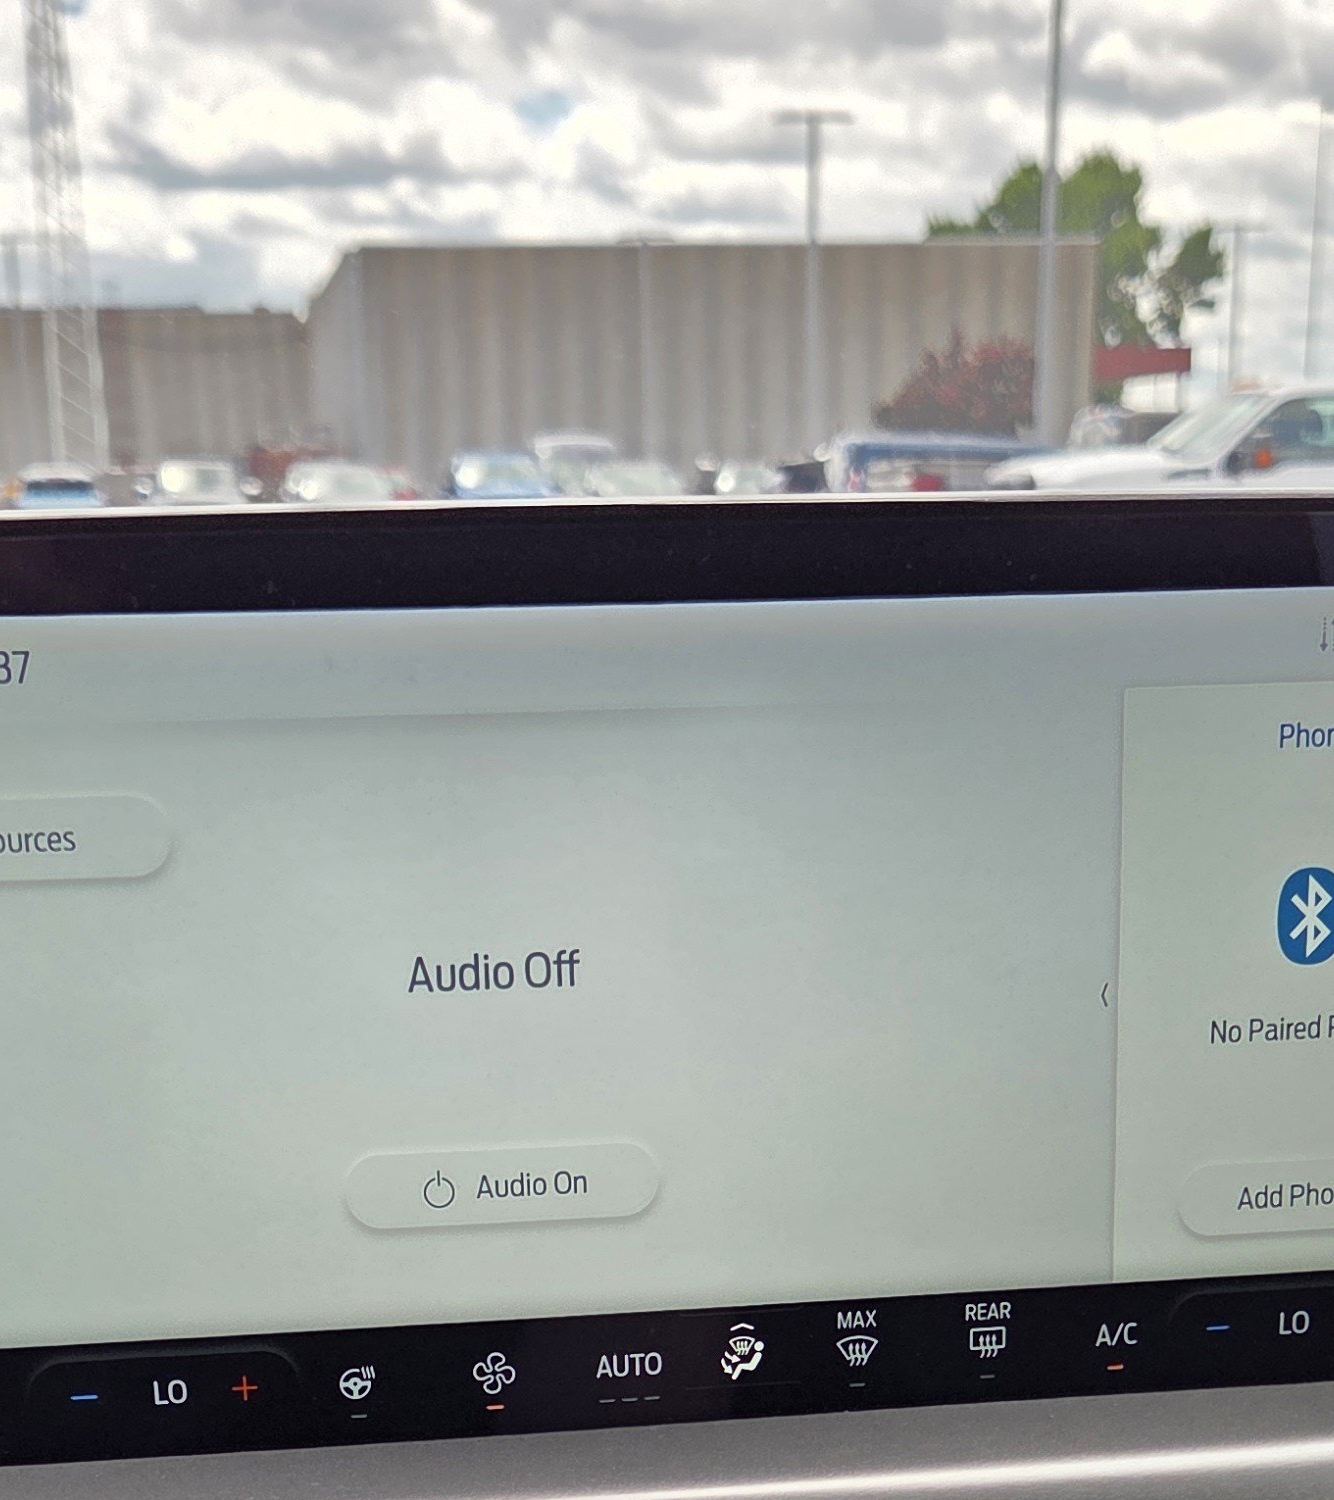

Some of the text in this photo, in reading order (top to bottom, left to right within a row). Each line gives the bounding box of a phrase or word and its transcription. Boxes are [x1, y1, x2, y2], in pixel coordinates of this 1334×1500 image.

[407, 948, 581, 994] Audio Off
[1209, 1018, 1242, 1045] No
[1248, 1014, 1321, 1043] Paired
[476, 1170, 588, 1200] Audio On
[1237, 1184, 1283, 1211] Add
[836, 1309, 878, 1331] MAX
[964, 1301, 1011, 1322] REAR
[1278, 1310, 1310, 1336] LO
[1094, 1321, 1138, 1348] A/C
[596, 1352, 663, 1380] AUTO
[153, 1379, 188, 1406] LO
